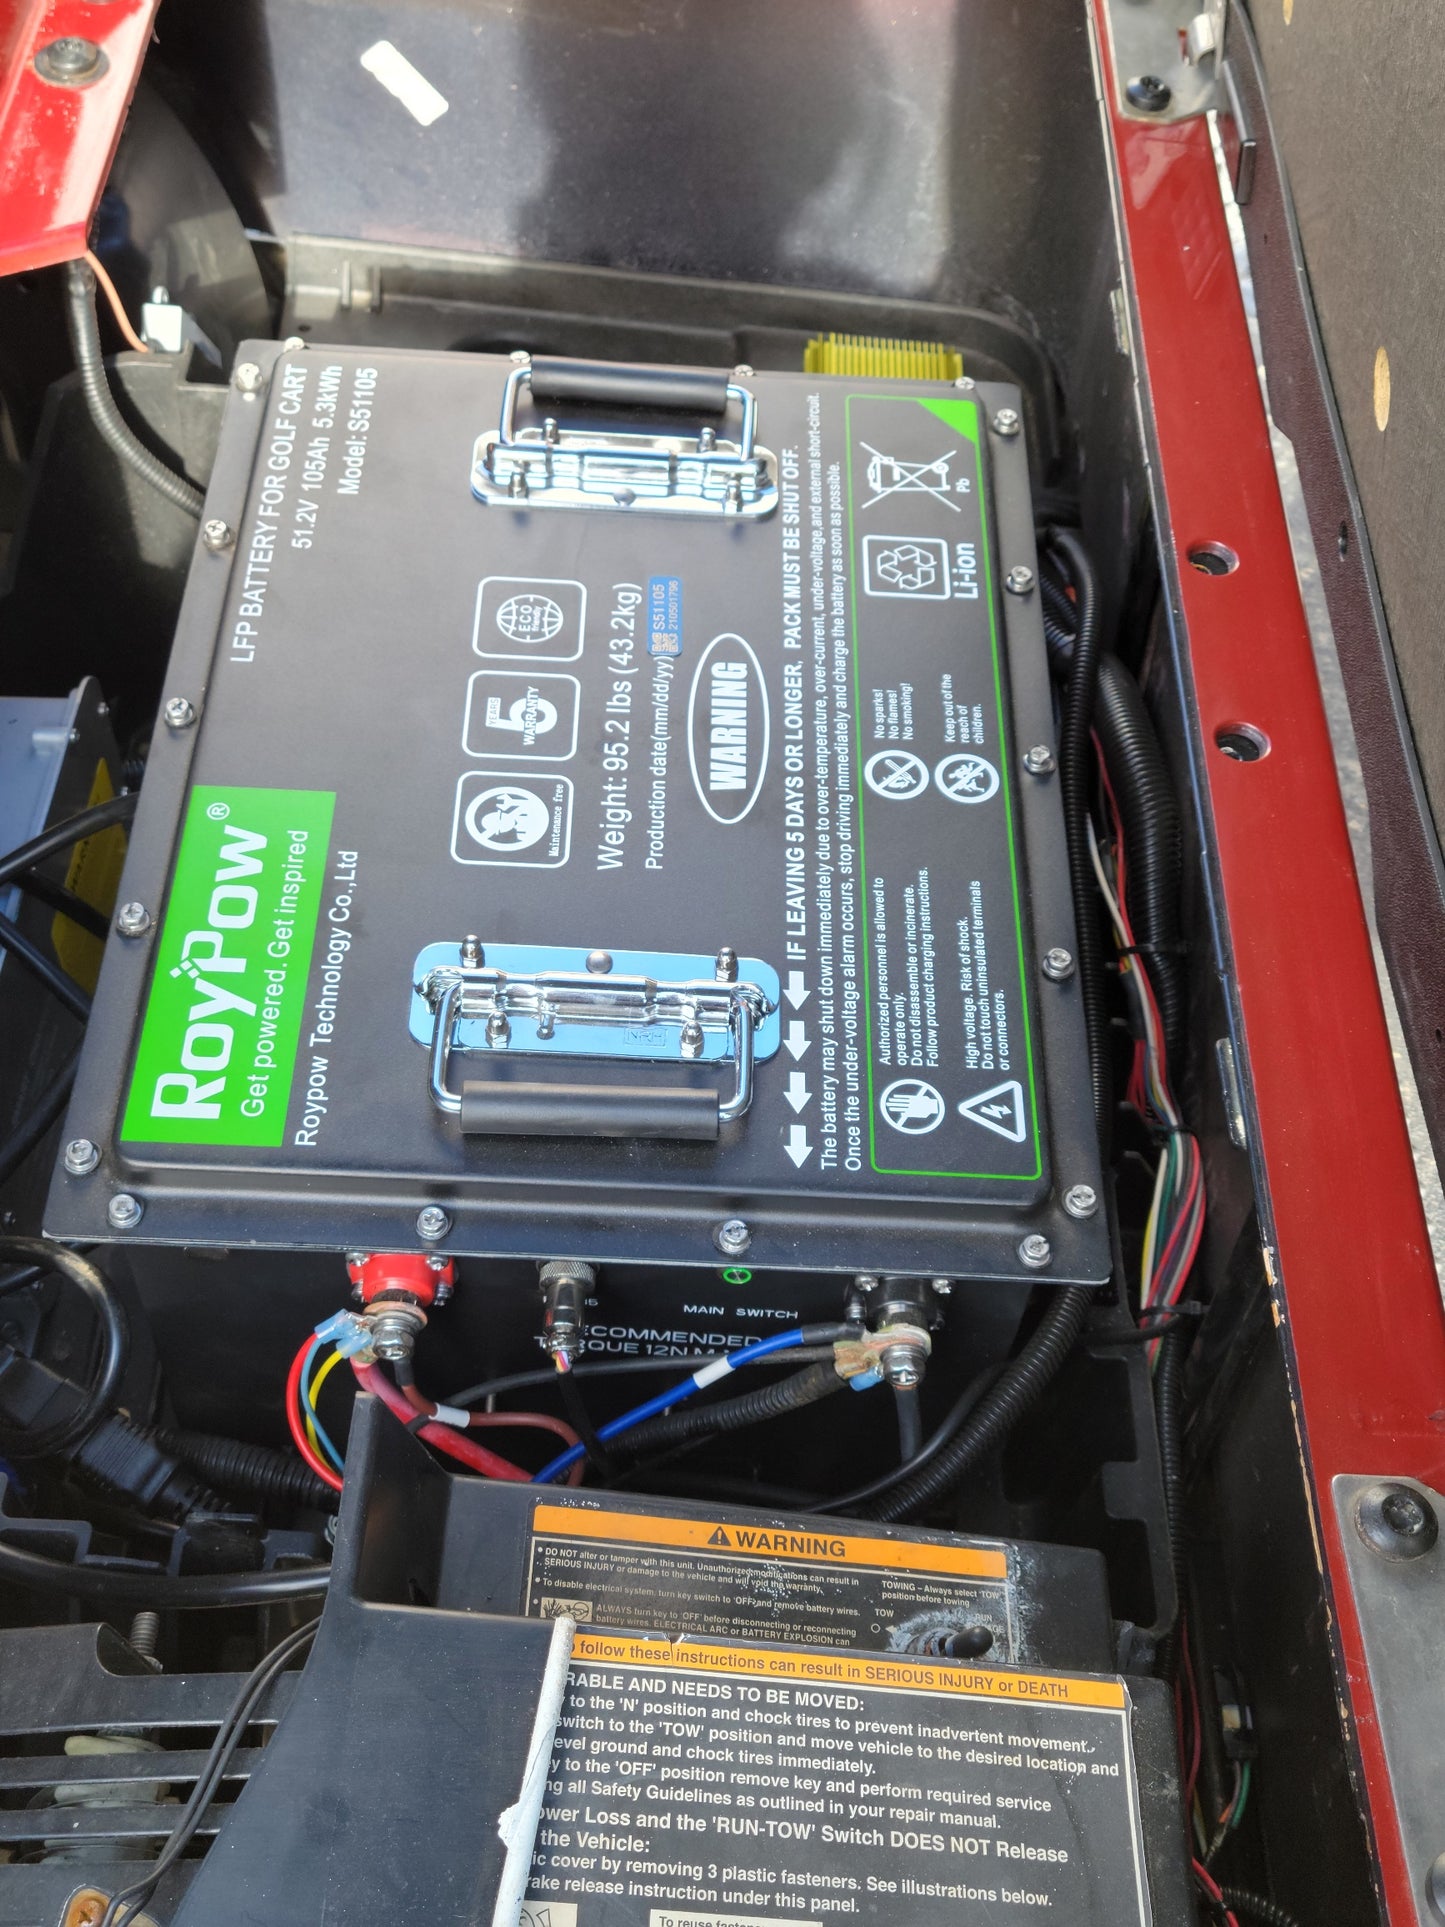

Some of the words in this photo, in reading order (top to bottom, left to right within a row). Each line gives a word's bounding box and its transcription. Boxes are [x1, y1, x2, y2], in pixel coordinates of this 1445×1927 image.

[277, 363, 308, 415] CART
[311, 365, 343, 429] 5.3kWh
[346, 367, 378, 432] S51105
[267, 417, 297, 471] GOLF
[807, 391, 820, 456] short-circuit.
[300, 436, 331, 492] 105Ah
[336, 434, 368, 495] Model:
[781, 445, 799, 479] OFF.
[808, 459, 822, 504] external
[257, 475, 288, 517] FOR
[782, 481, 800, 525] SHUT
[955, 477, 971, 493] Pb
[290, 498, 319, 550] 51.2V
[782, 527, 800, 550] BE
[238, 520, 278, 617] BATTERY
[782, 551, 801, 599] MUST
[952, 542, 979, 599] Li-ion
[518, 604, 532, 631] ECO
[653, 583, 665, 631] S51105
[783, 601, 802, 649] PACK
[229, 621, 259, 663] LFP
[607, 582, 643, 675] (43.2kg)
[811, 613, 827, 693] over-current,
[605, 680, 633, 713] lbs
[783, 660, 804, 740] LONGER,
[940, 673, 953, 690] the
[940, 689, 954, 701] of
[484, 694, 558, 734] 5
[487, 697, 498, 725] YEARS
[523, 685, 539, 745] WARRANTY
[872, 688, 887, 724] sparks!
[886, 689, 899, 724] flames!
[899, 682, 914, 726] smoking!
[942, 700, 954, 717] out
[955, 704, 968, 715] of
[971, 703, 985, 745] children.
[602, 719, 630, 771] 95.2
[709, 662, 748, 791] WARNING
[873, 724, 885, 739] No
[888, 725, 900, 740] No
[901, 726, 914, 741] No
[944, 717, 957, 743] Keep
[957, 716, 970, 743] reach
[784, 744, 804, 772] OR
[813, 695, 832, 815] over-temperature,
[552, 783, 564, 803] free
[784, 776, 805, 828] DAYS
[548, 806, 563, 857] Maintenance
[597, 776, 633, 870] Weight:
[644, 780, 666, 870] Production
[785, 831, 805, 843] 5
[815, 817, 830, 831] to
[815, 833, 831, 861] due
[273, 829, 309, 914] inspired
[785, 847, 806, 937] LEAVING
[872, 877, 884, 888] to
[815, 862, 835, 952] immediately
[872, 889, 886, 932] allowed
[903, 884, 917, 941] incinerate.
[917, 866, 932, 932] instructions.
[969, 880, 984, 930] terminals
[266, 918, 295, 958] Get
[786, 941, 807, 961] IF
[874, 933, 887, 943] is
[907, 942, 918, 955] or
[956, 916, 971, 952] shock.
[150, 824, 268, 1120] RoyPow
[817, 955, 834, 997] down
[874, 944, 892, 1000] personnel
[920, 933, 936, 982] charging
[958, 952, 972, 965] of
[972, 931, 989, 996] uninsulated
[309, 927, 352, 1048] Technology
[905, 956, 921, 1027] disassemble
[959, 966, 973, 992] Risk
[253, 963, 288, 1068] powered.
[818, 999, 835, 1034] shut
[892, 992, 907, 1019] only.
[922, 983, 940, 1027] product
[962, 994, 978, 1040] voltage.
[977, 998, 991, 1030] touch
[993, 989, 1009, 1057] connectors.
[822, 1037, 839, 1071] may
[876, 1002, 892, 1066] Authorized
[894, 1020, 910, 1066] operate
[909, 1028, 922, 1047] not
[925, 1028, 939, 1068] Follow
[964, 1041, 981, 1069] High
[980, 1031, 993, 1051] not
[910, 1049, 924, 1067] Do
[980, 1052, 994, 1070] Do
[998, 1057, 1011, 1071] or
[240, 1074, 270, 1117] Get
[294, 1055, 329, 1146] Roypow
[820, 1074, 839, 1134] battery
[820, 1137, 838, 1171] The
[683, 1304, 724, 1316] MAIN
[735, 1307, 799, 1320] SWITCH
[735, 1530, 846, 1558] WARNING
[881, 1580, 916, 1592] TOWING
[923, 1584, 953, 1597] Always
[954, 1588, 977, 1598] select
[881, 1590, 912, 1602] position
[916, 1593, 941, 1603] before
[943, 1597, 969, 1608] towing
[874, 1607, 895, 1618] TOW
[579, 1639, 626, 1657] follow
[629, 1643, 670, 1661] these
[676, 1648, 765, 1670] instructions
[769, 1660, 796, 1673] can
[801, 1662, 843, 1677] result
[847, 1664, 861, 1678] in
[865, 1665, 935, 1685] SERIOUS
[939, 1672, 994, 1691] INJURY
[998, 1681, 1014, 1693] or
[1017, 1680, 1069, 1698] DEATH
[627, 1677, 667, 1694] AND
[671, 1680, 733, 1700] NEEDS
[736, 1686, 761, 1702] TO
[766, 1688, 790, 1705] BE
[795, 1691, 864, 1712] MOVED:
[584, 1806, 631, 1826] Loss
[635, 1812, 672, 1830] and
[676, 1813, 707, 1832] the
[712, 1816, 816, 1840] 'RUN-TOW'
[821, 1825, 884, 1847] Switch
[890, 1830, 945, 1852] DOES
[950, 1836, 991, 1856] NOT
[996, 1840, 1069, 1864] Release
[550, 1855, 598, 1870] cover
[601, 1855, 622, 1875] by
[625, 1860, 703, 1881] removing
[707, 1863, 718, 1879] 3
[722, 1865, 777, 1884] plastic
[780, 1869, 862, 1891] fasteners.
[866, 1876, 898, 1893] See
[901, 1878, 998, 1902] illustrations
[1001, 1887, 1053, 1907] below.
